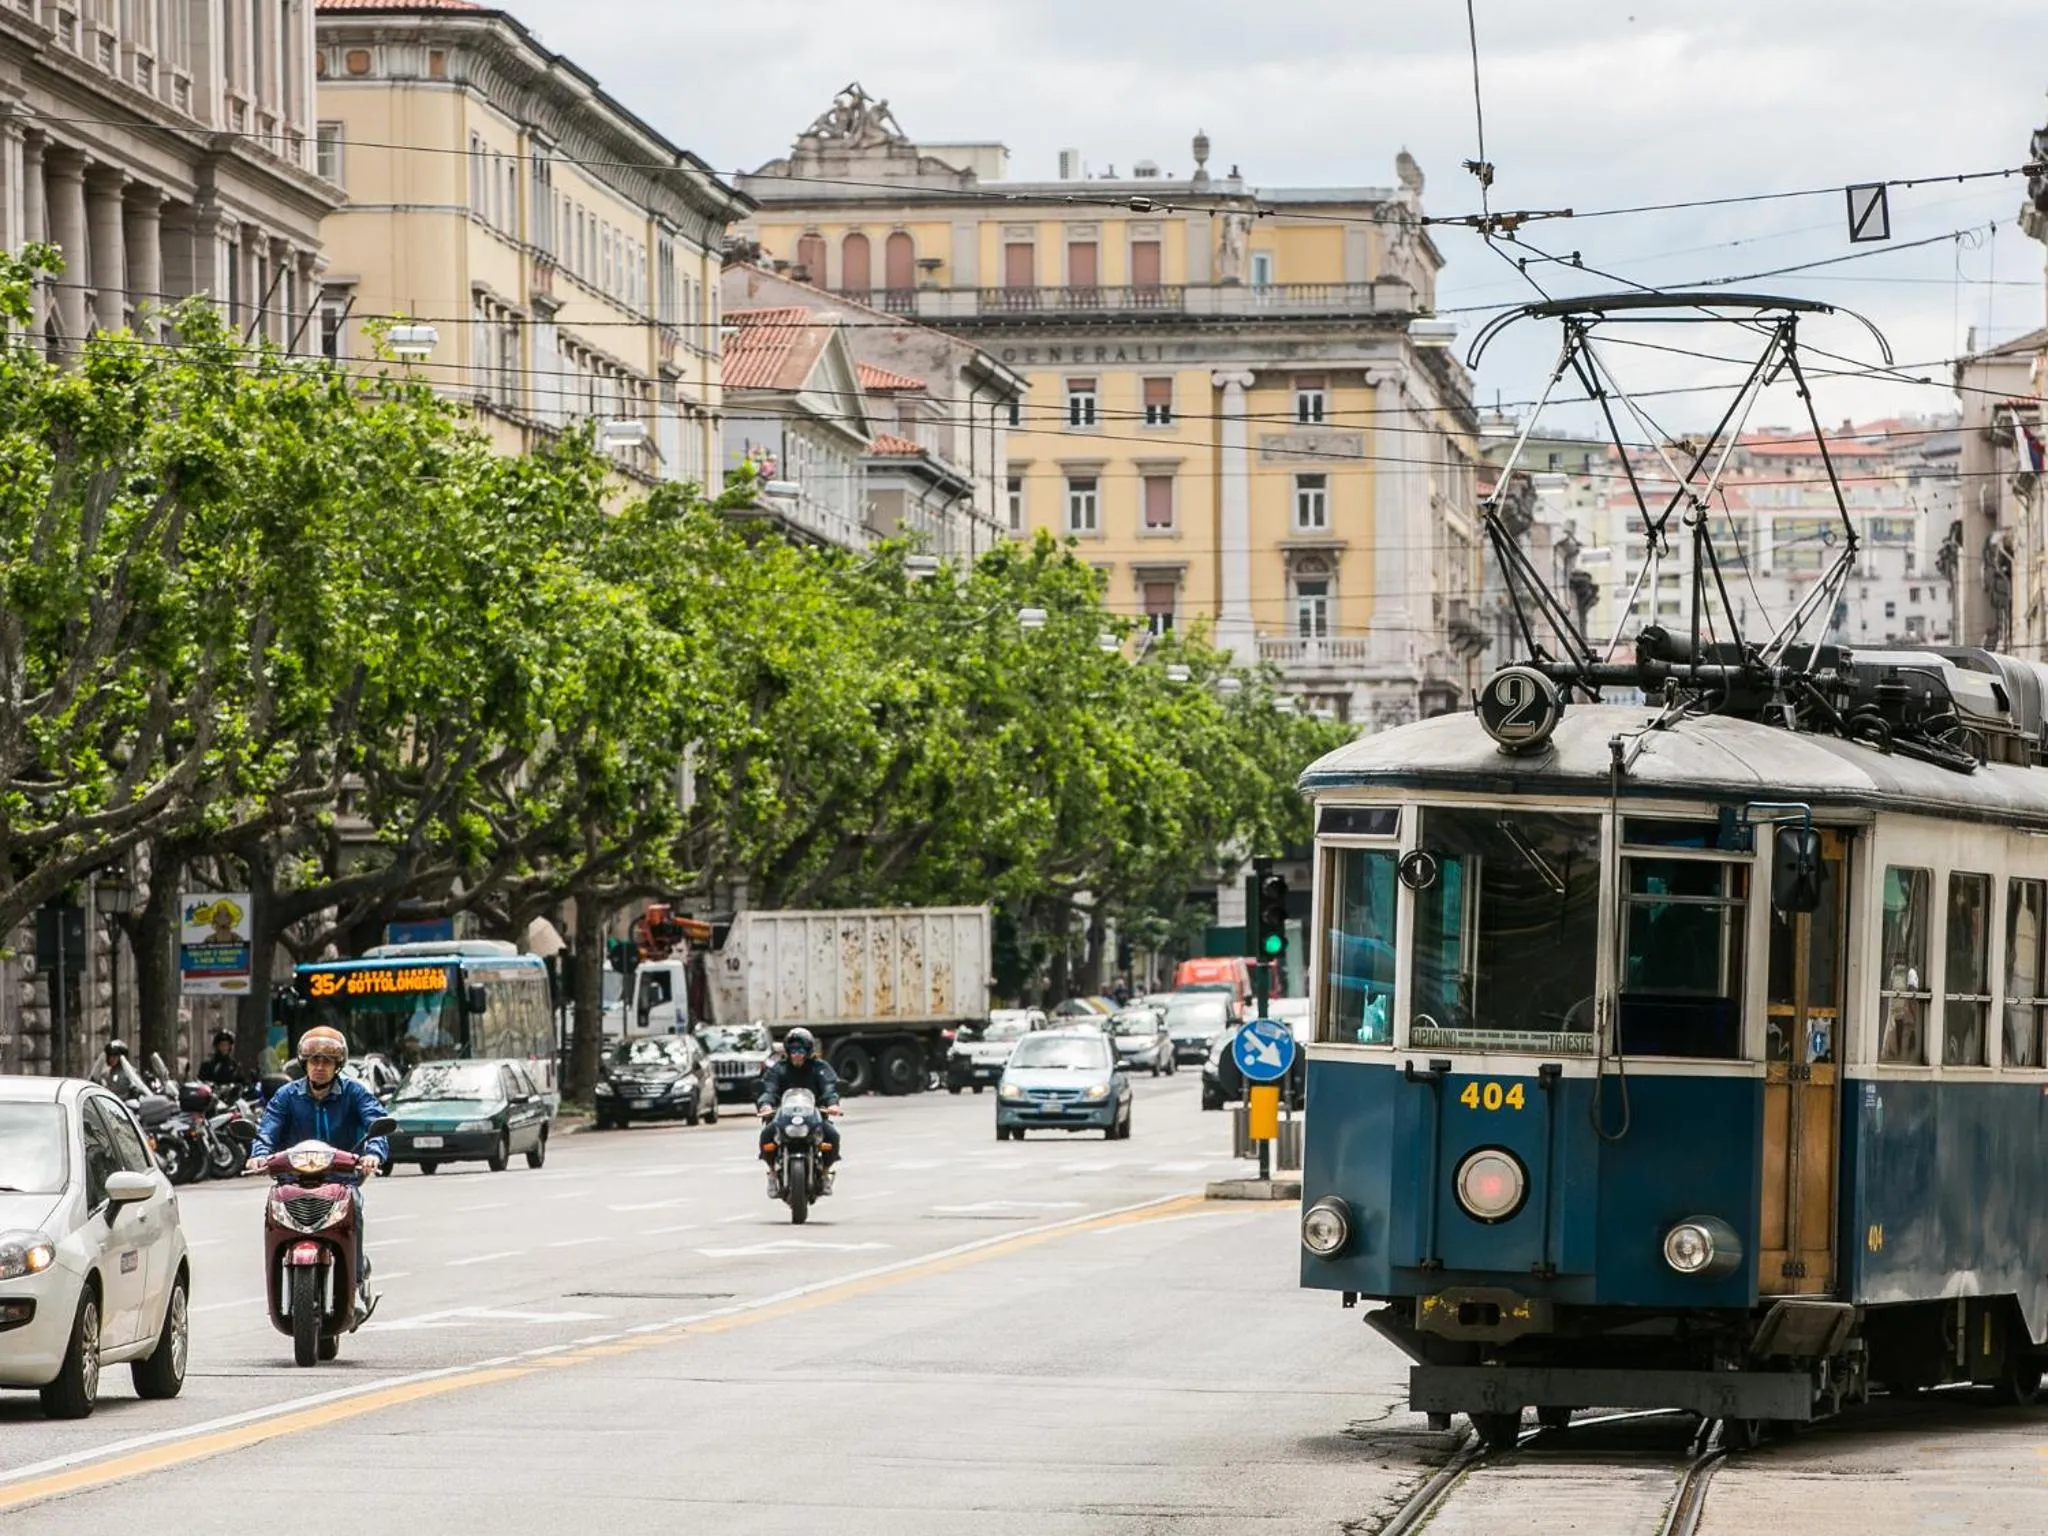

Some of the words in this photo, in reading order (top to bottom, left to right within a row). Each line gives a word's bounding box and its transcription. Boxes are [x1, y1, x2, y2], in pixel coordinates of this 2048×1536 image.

[1001, 345, 1163, 363] GENERALI
[1496, 673, 1536, 737] 2
[726, 957, 740, 971] 10
[1549, 1033, 1593, 1053] TRIESTE
[1460, 1081, 1525, 1111] 404
[1868, 1223, 1883, 1252] 404
